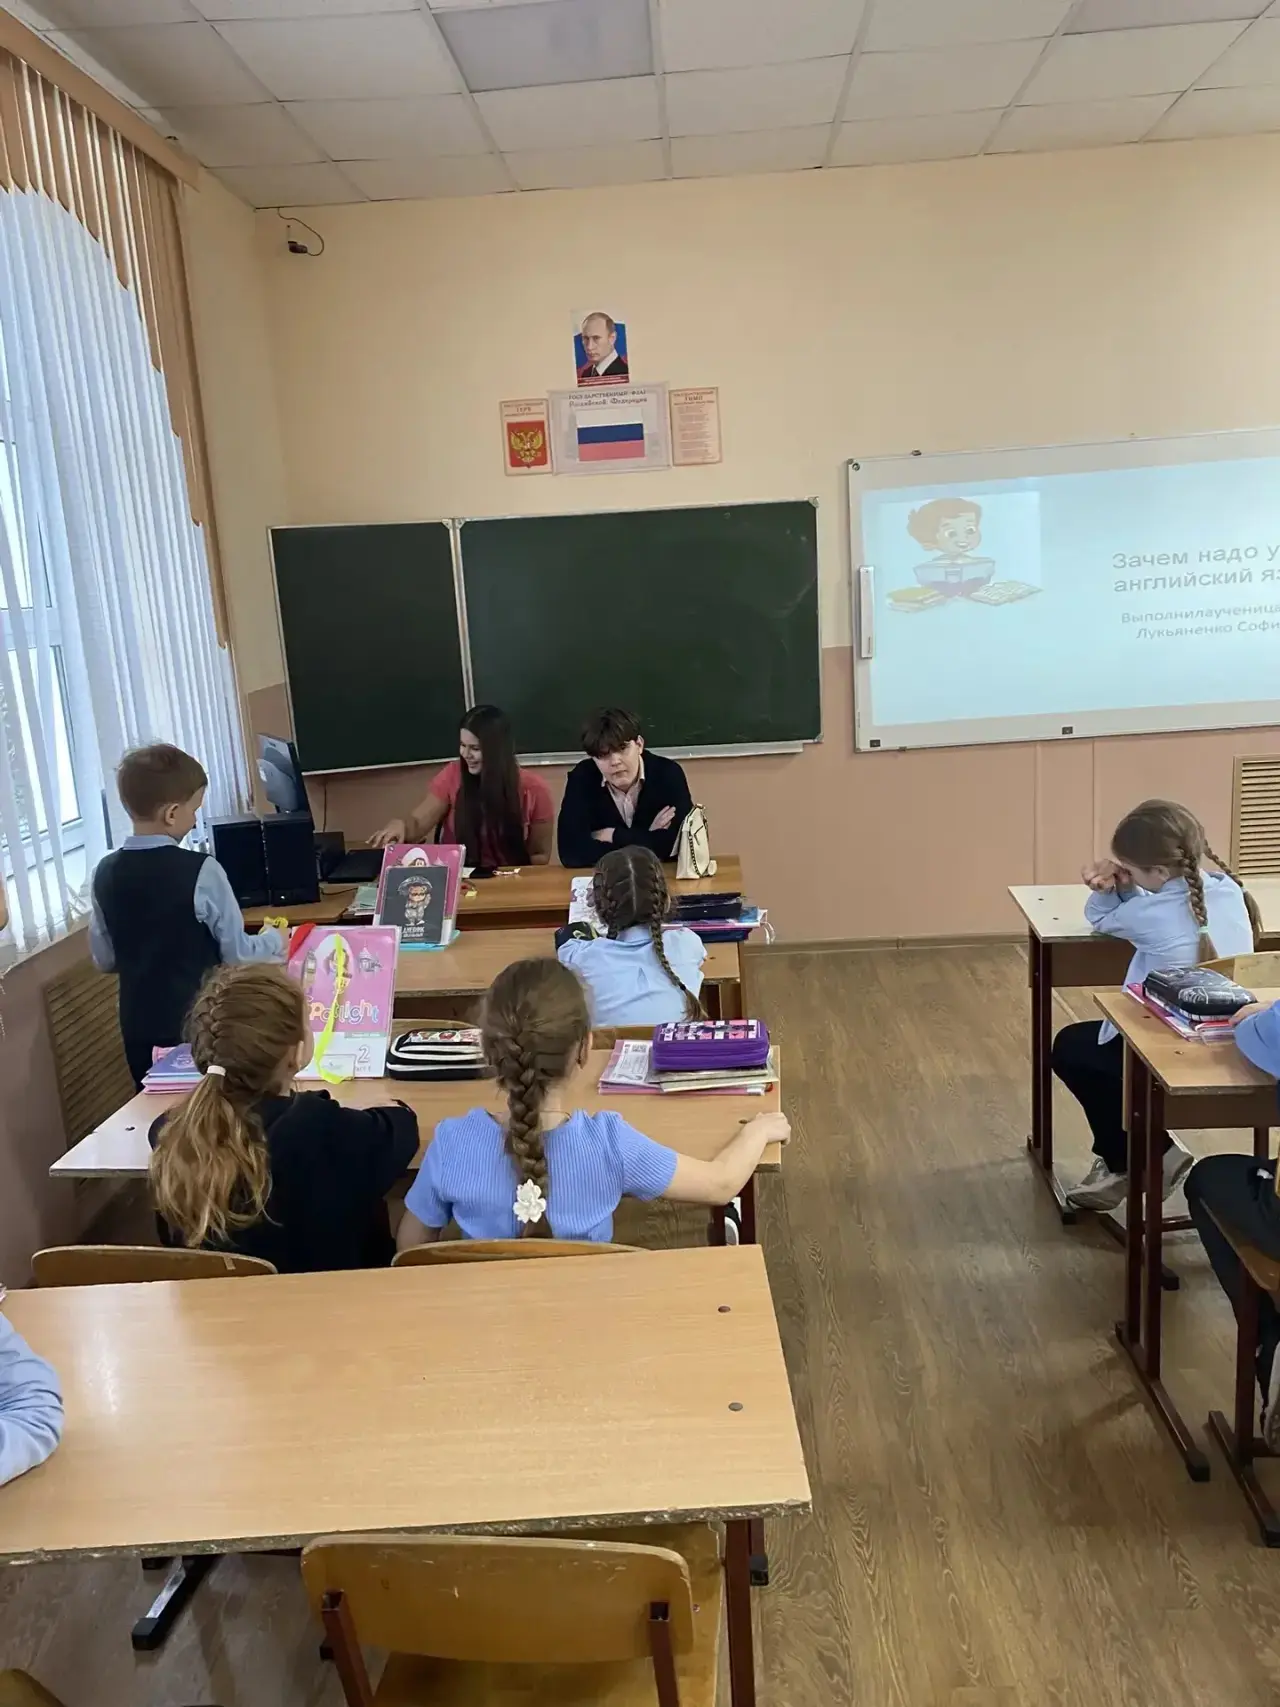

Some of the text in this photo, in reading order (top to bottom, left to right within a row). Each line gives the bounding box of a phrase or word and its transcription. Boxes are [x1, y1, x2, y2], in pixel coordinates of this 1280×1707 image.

[1112, 552, 1189, 569] Зачем
[1198, 546, 1258, 563] надо
[1114, 568, 1252, 592] английский
[1136, 624, 1233, 640] Лукьяненко
[357, 1043, 372, 1065] 2
